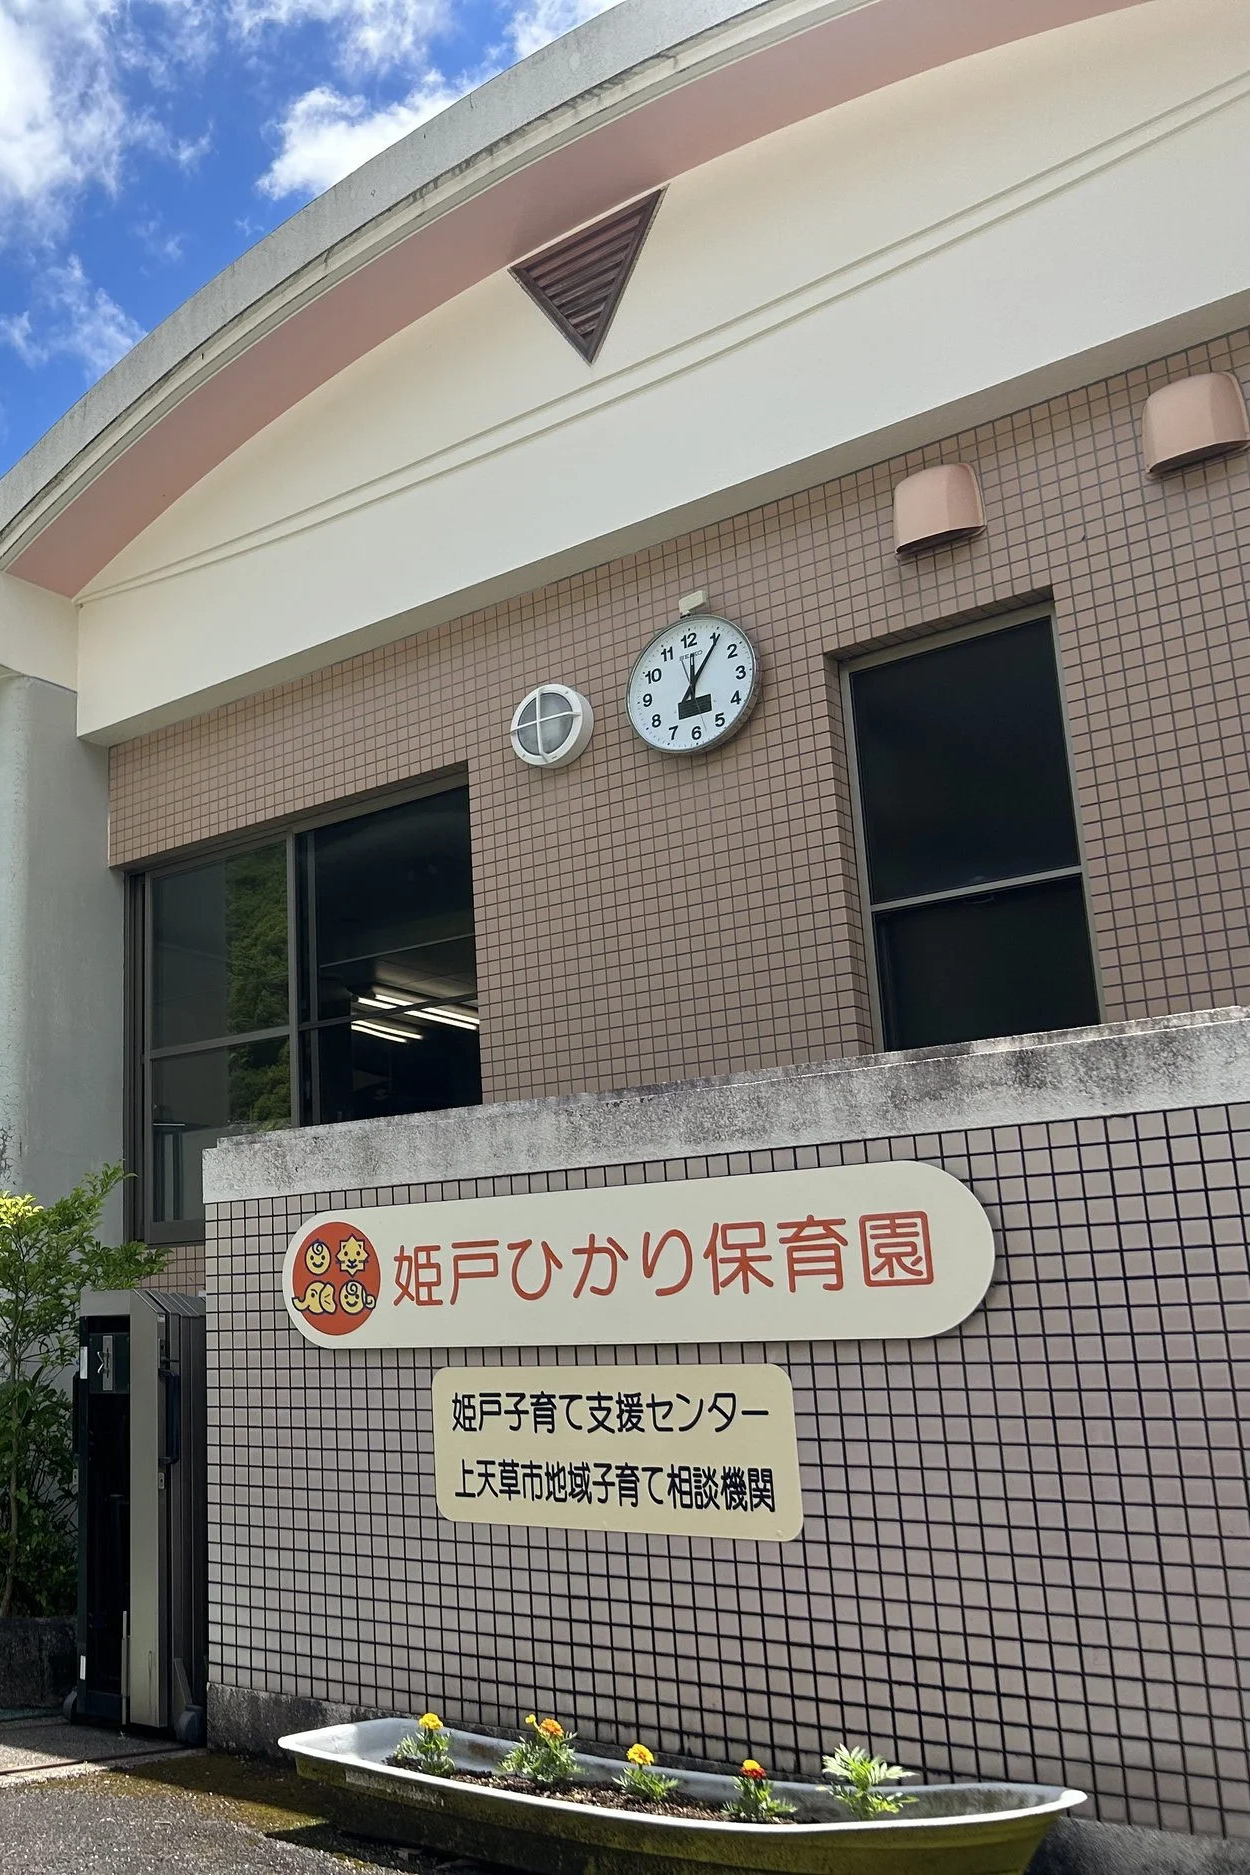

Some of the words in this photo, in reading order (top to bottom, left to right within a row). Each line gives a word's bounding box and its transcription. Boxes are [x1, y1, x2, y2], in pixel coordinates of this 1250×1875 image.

[680, 632, 698, 649] 12
[660, 646, 674, 662] 11
[680, 650, 702, 662] SEKO
[726, 643, 738, 659] 2
[644, 668, 662, 685] 10
[735, 665, 747, 680] 3
[642, 693, 653, 708] 9
[730, 690, 742, 705] 4
[651, 713, 662, 728] 8
[714, 712, 726, 728] 5
[668, 725, 679, 741] 7
[691, 725, 702, 741] 6
[393, 1212, 933, 1306] 姫戸ひかり保育園
[451, 1390, 769, 1435] 姫戸子育て支援センター
[454, 1458, 776, 1513] 上天草市地域子育て相談機関
